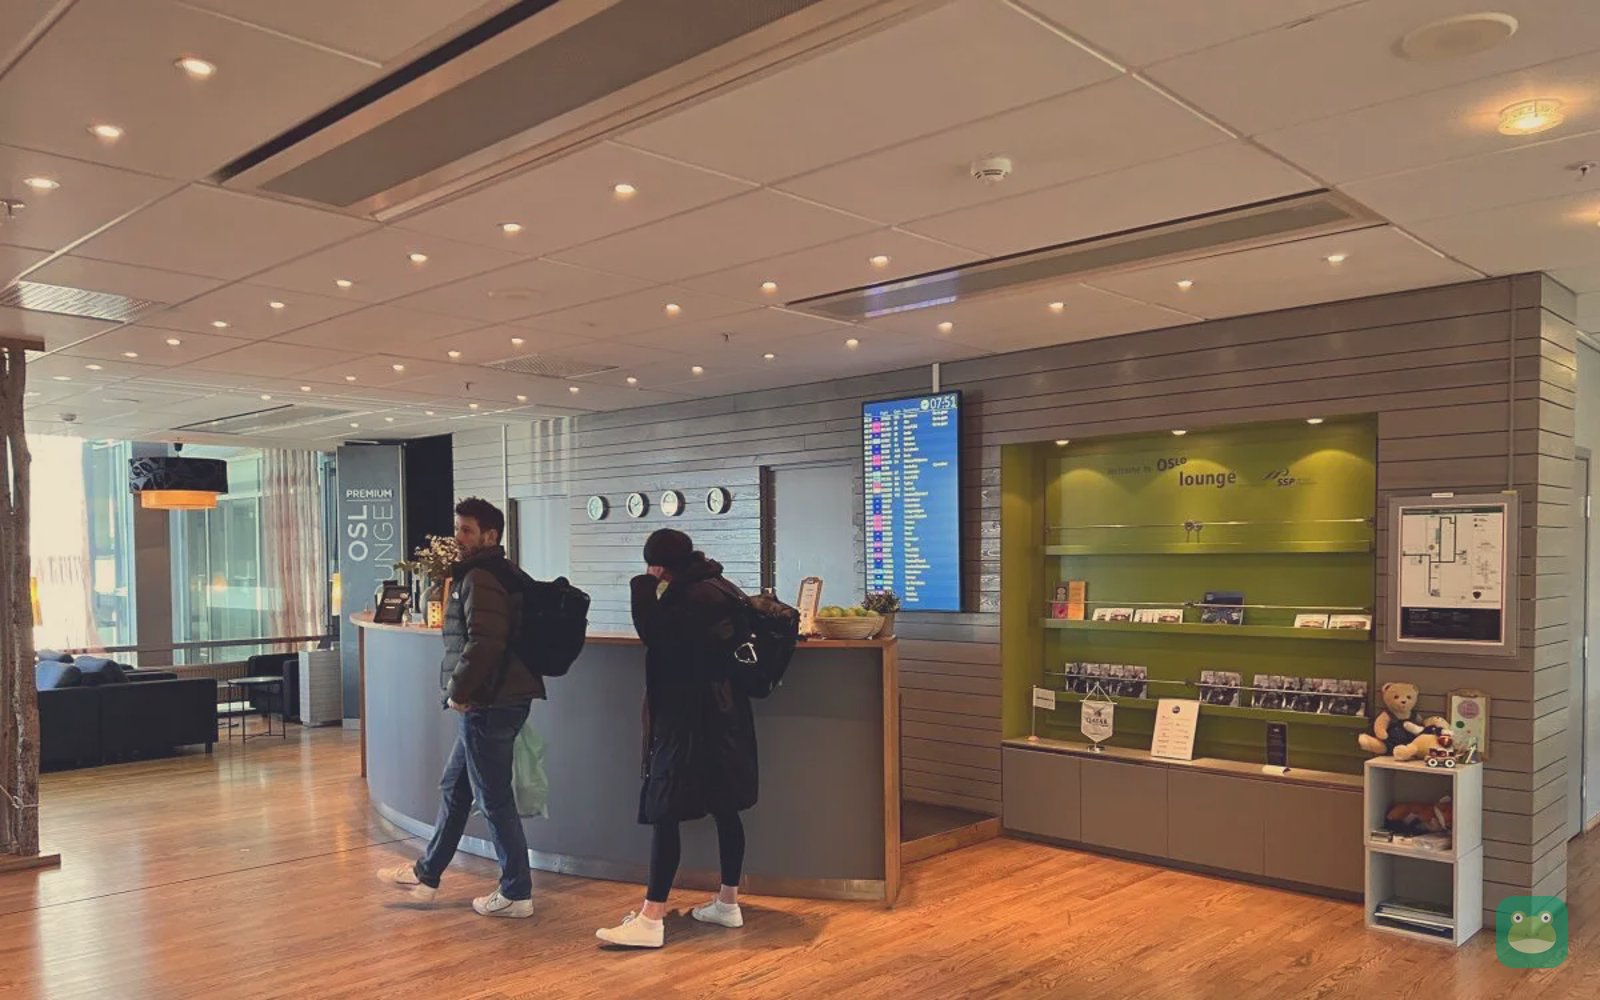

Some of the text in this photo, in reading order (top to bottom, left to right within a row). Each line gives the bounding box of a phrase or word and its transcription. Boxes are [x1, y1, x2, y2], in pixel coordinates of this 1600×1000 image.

[930, 394, 957, 409] 07:51
[1180, 471, 1236, 488] lounge
[1278, 477, 1296, 487] SSP
[346, 489, 392, 498] PREMIUM
[348, 505, 368, 562] OSL
[373, 504, 394, 597] UNGE
